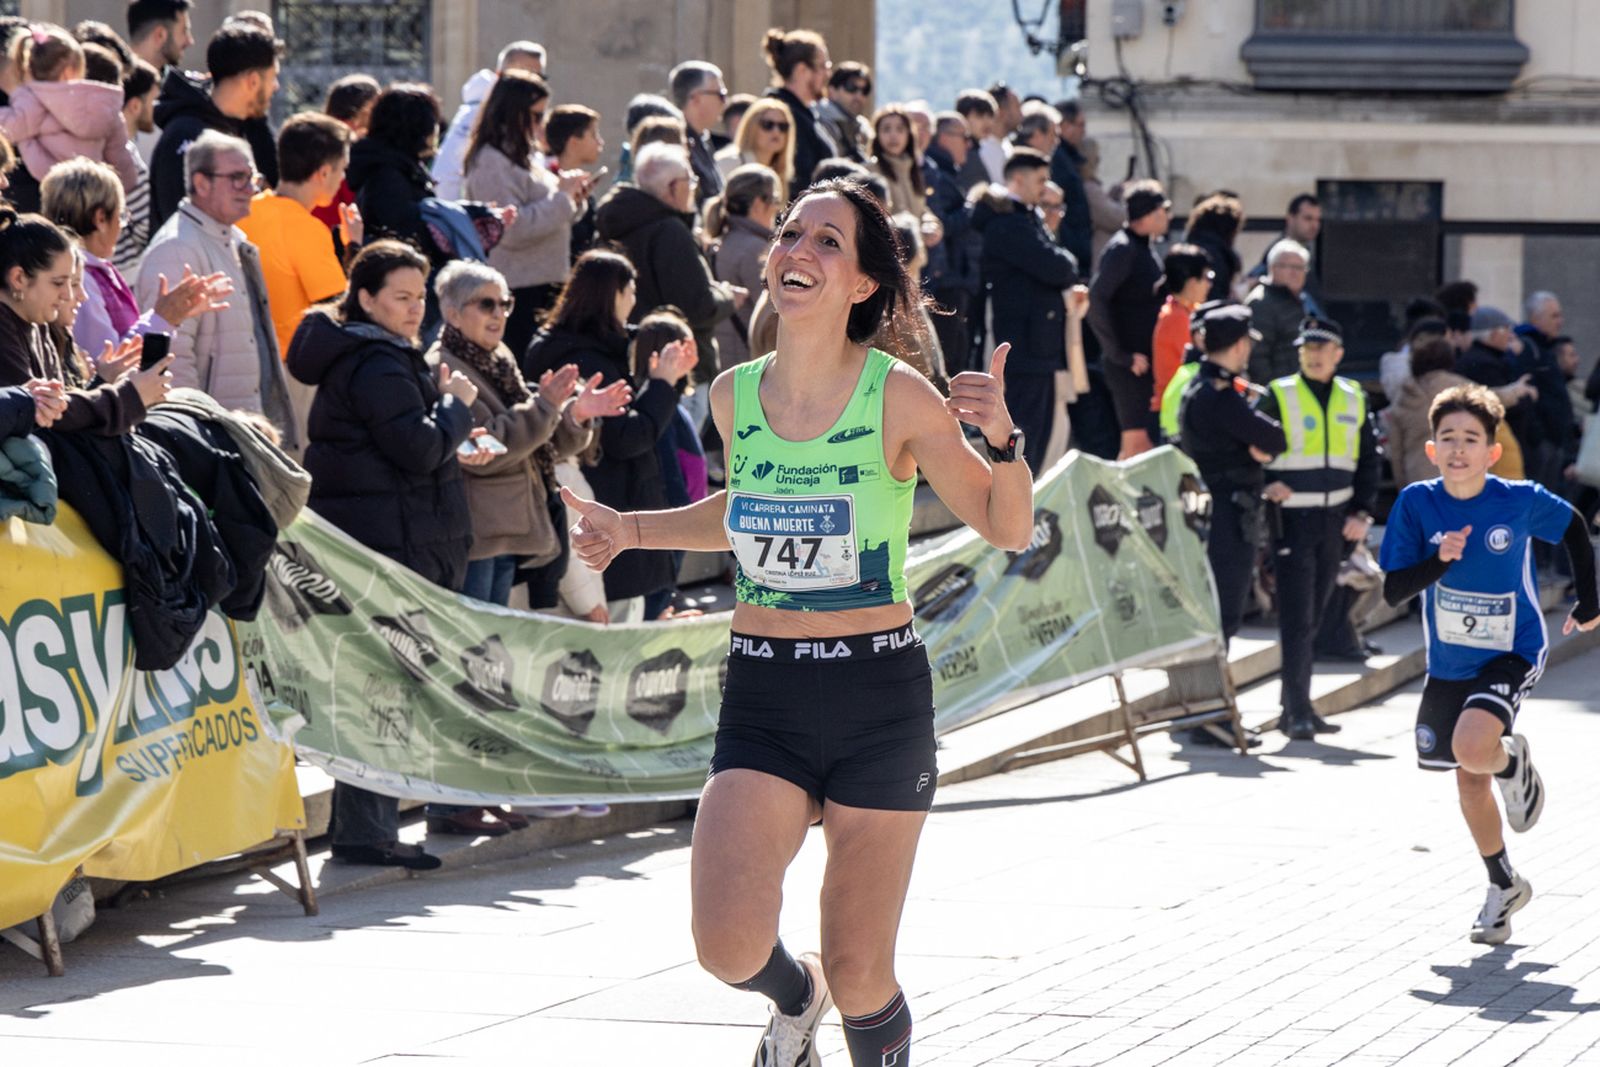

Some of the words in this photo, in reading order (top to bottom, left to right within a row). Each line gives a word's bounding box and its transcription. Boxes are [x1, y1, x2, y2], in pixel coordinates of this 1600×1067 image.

[777, 463, 838, 475] Fundación
[775, 474, 820, 487] Unicaja
[749, 502, 787, 514] CARRERA
[788, 503, 835, 514] CAMINATA
[739, 515, 771, 531] BUENA
[773, 518, 815, 532] MUERTE
[754, 536, 823, 570] 747
[1462, 615, 1477, 634] 9
[732, 636, 775, 659] FILA
[794, 640, 853, 660] FILA
[872, 627, 914, 653] FILA
